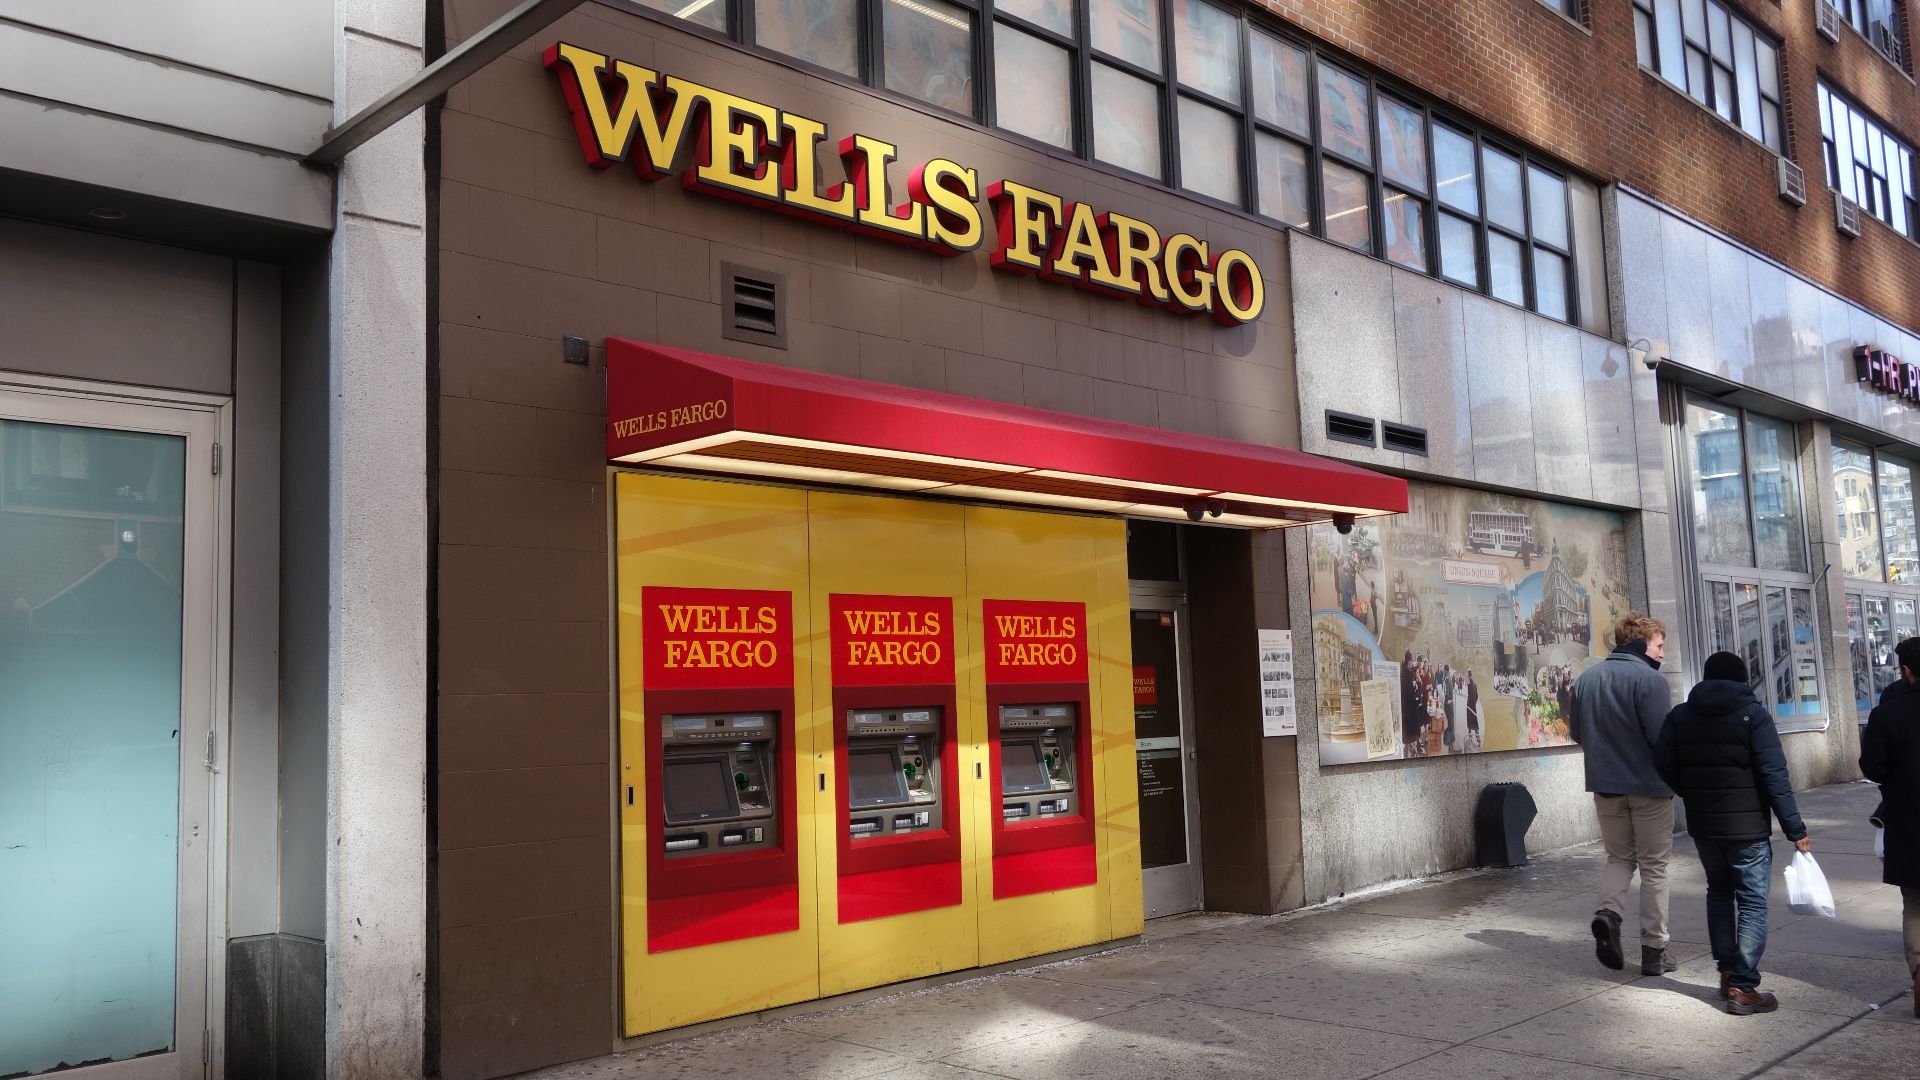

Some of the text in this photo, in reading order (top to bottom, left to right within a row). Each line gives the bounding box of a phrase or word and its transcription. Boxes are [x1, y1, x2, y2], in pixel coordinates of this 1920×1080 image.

[547, 41, 1265, 325] WELLS FARGO
[613, 399, 728, 439] WELLS FARGO
[658, 604, 778, 634] WELLS
[843, 610, 941, 636] WELLS
[994, 615, 1076, 639] WELLS
[663, 640, 778, 668] FARGO
[847, 640, 941, 666] FARGO
[998, 643, 1077, 666] FARGO
